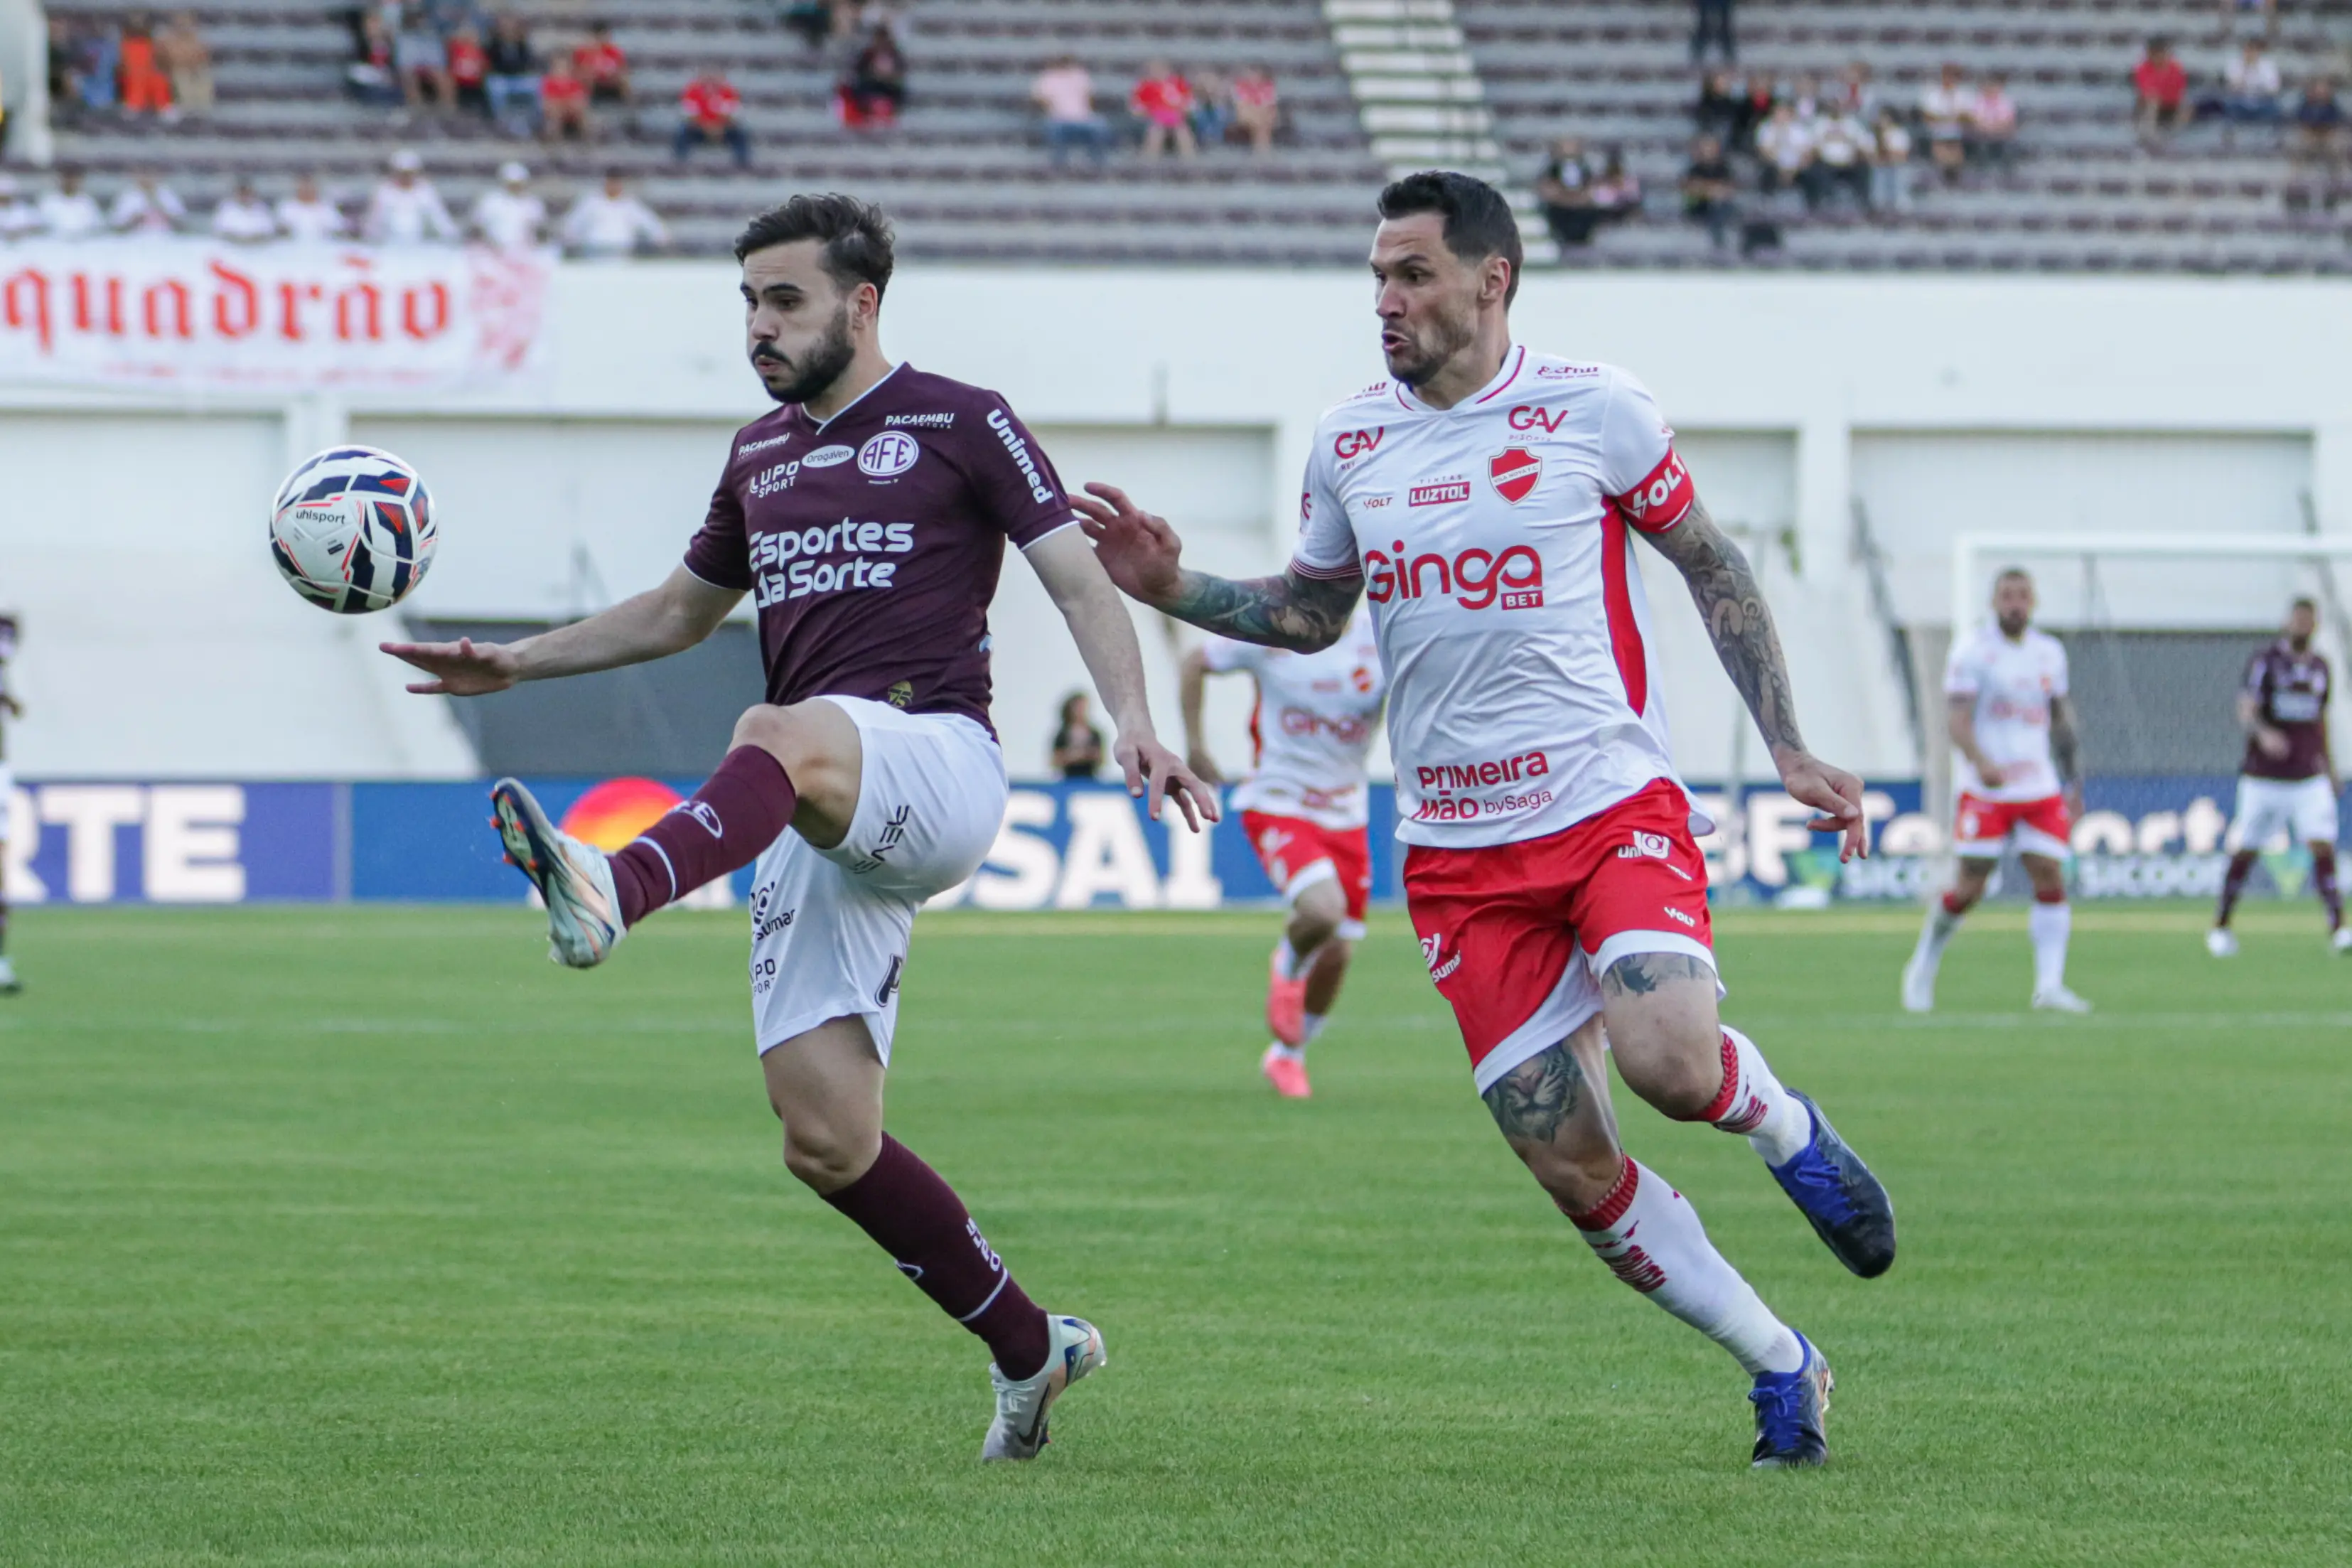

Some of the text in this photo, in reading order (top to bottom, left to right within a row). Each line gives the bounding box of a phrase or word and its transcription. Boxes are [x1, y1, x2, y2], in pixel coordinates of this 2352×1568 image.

[884, 412, 955, 426] PACAEMBU
[1508, 405, 1569, 434] GAV
[807, 449, 850, 464] DrogaVen
[863, 437, 911, 470] AFE
[987, 409, 1054, 504] Unimed
[1334, 426, 1385, 459] GAV
[750, 461, 800, 493] LUPO
[758, 476, 796, 498] SPORT
[1411, 485, 1468, 504] LUZTOL
[296, 510, 346, 525] uhlsport
[749, 517, 915, 573] Esportes
[1365, 539, 1542, 610] Ginga
[1506, 593, 1540, 607] BET
[755, 908, 795, 940] sumar
[966, 1217, 1001, 1272] LUPO
